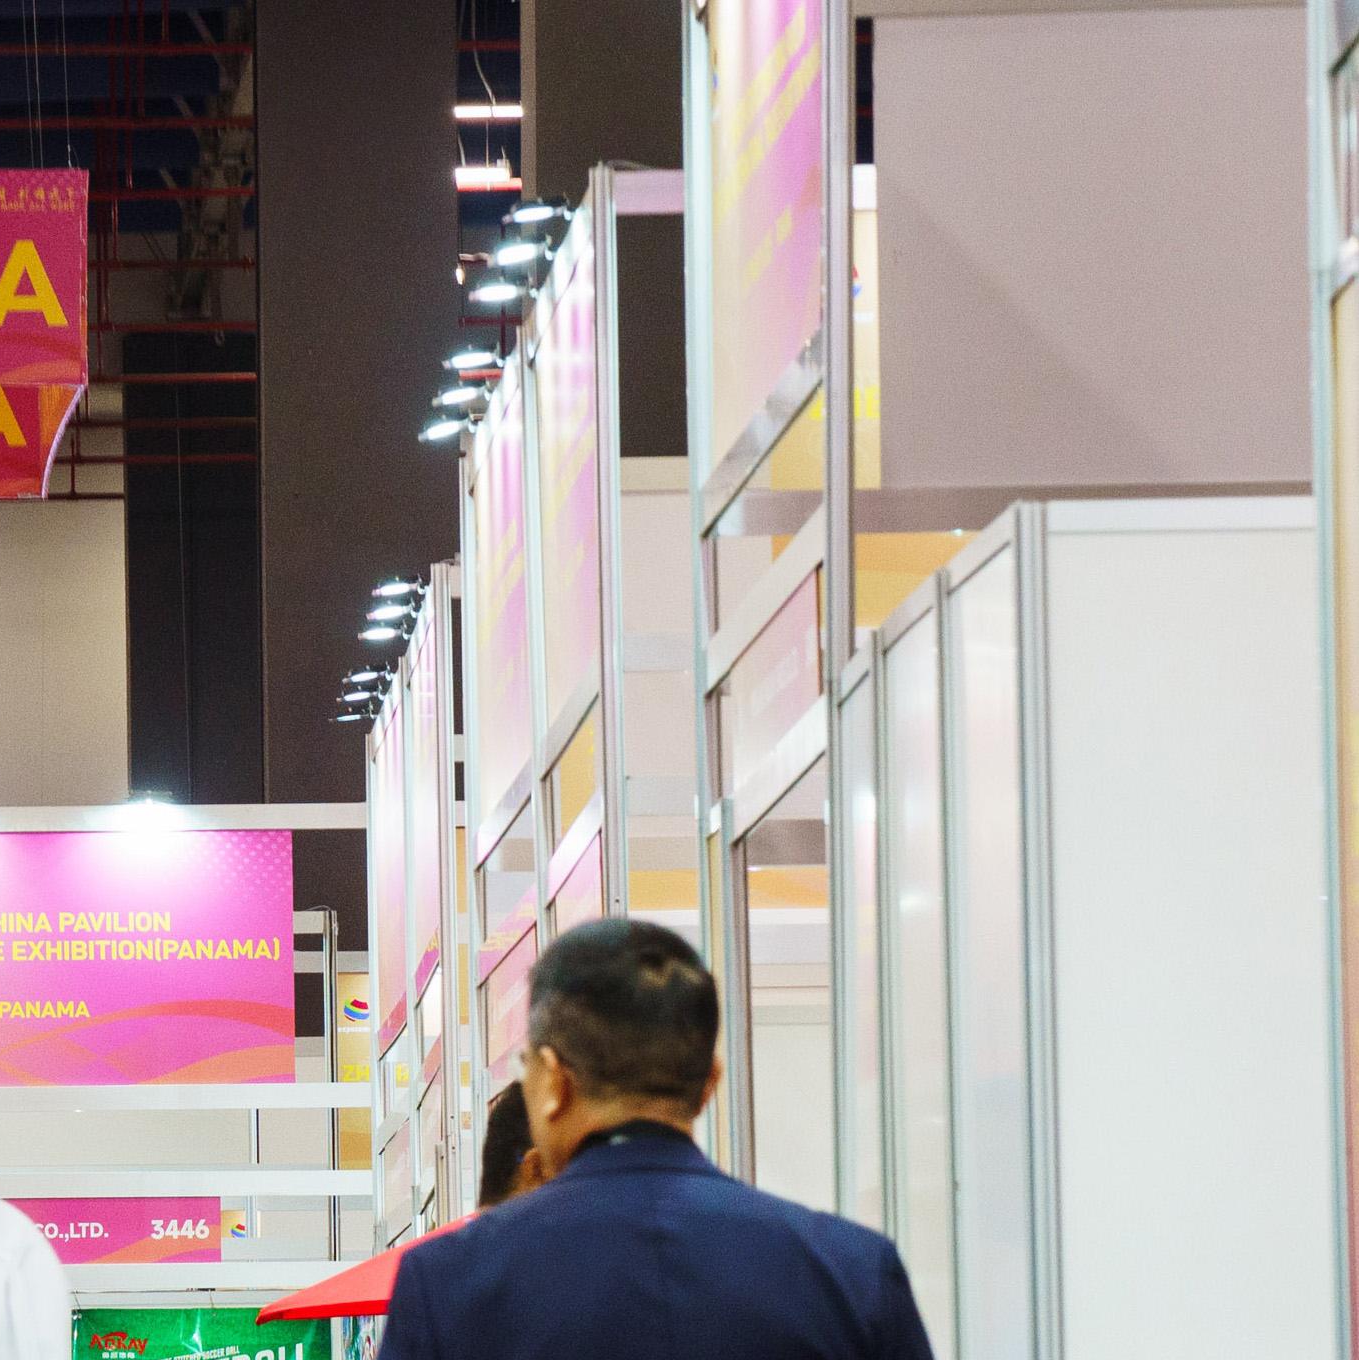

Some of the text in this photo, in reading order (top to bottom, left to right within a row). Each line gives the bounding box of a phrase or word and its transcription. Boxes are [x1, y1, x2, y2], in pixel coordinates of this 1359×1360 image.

[59, 911, 171, 932] PAVILION
[12, 937, 280, 961] EXHIBITION(PANAMA)
[151, 1220, 210, 1239] 3446
